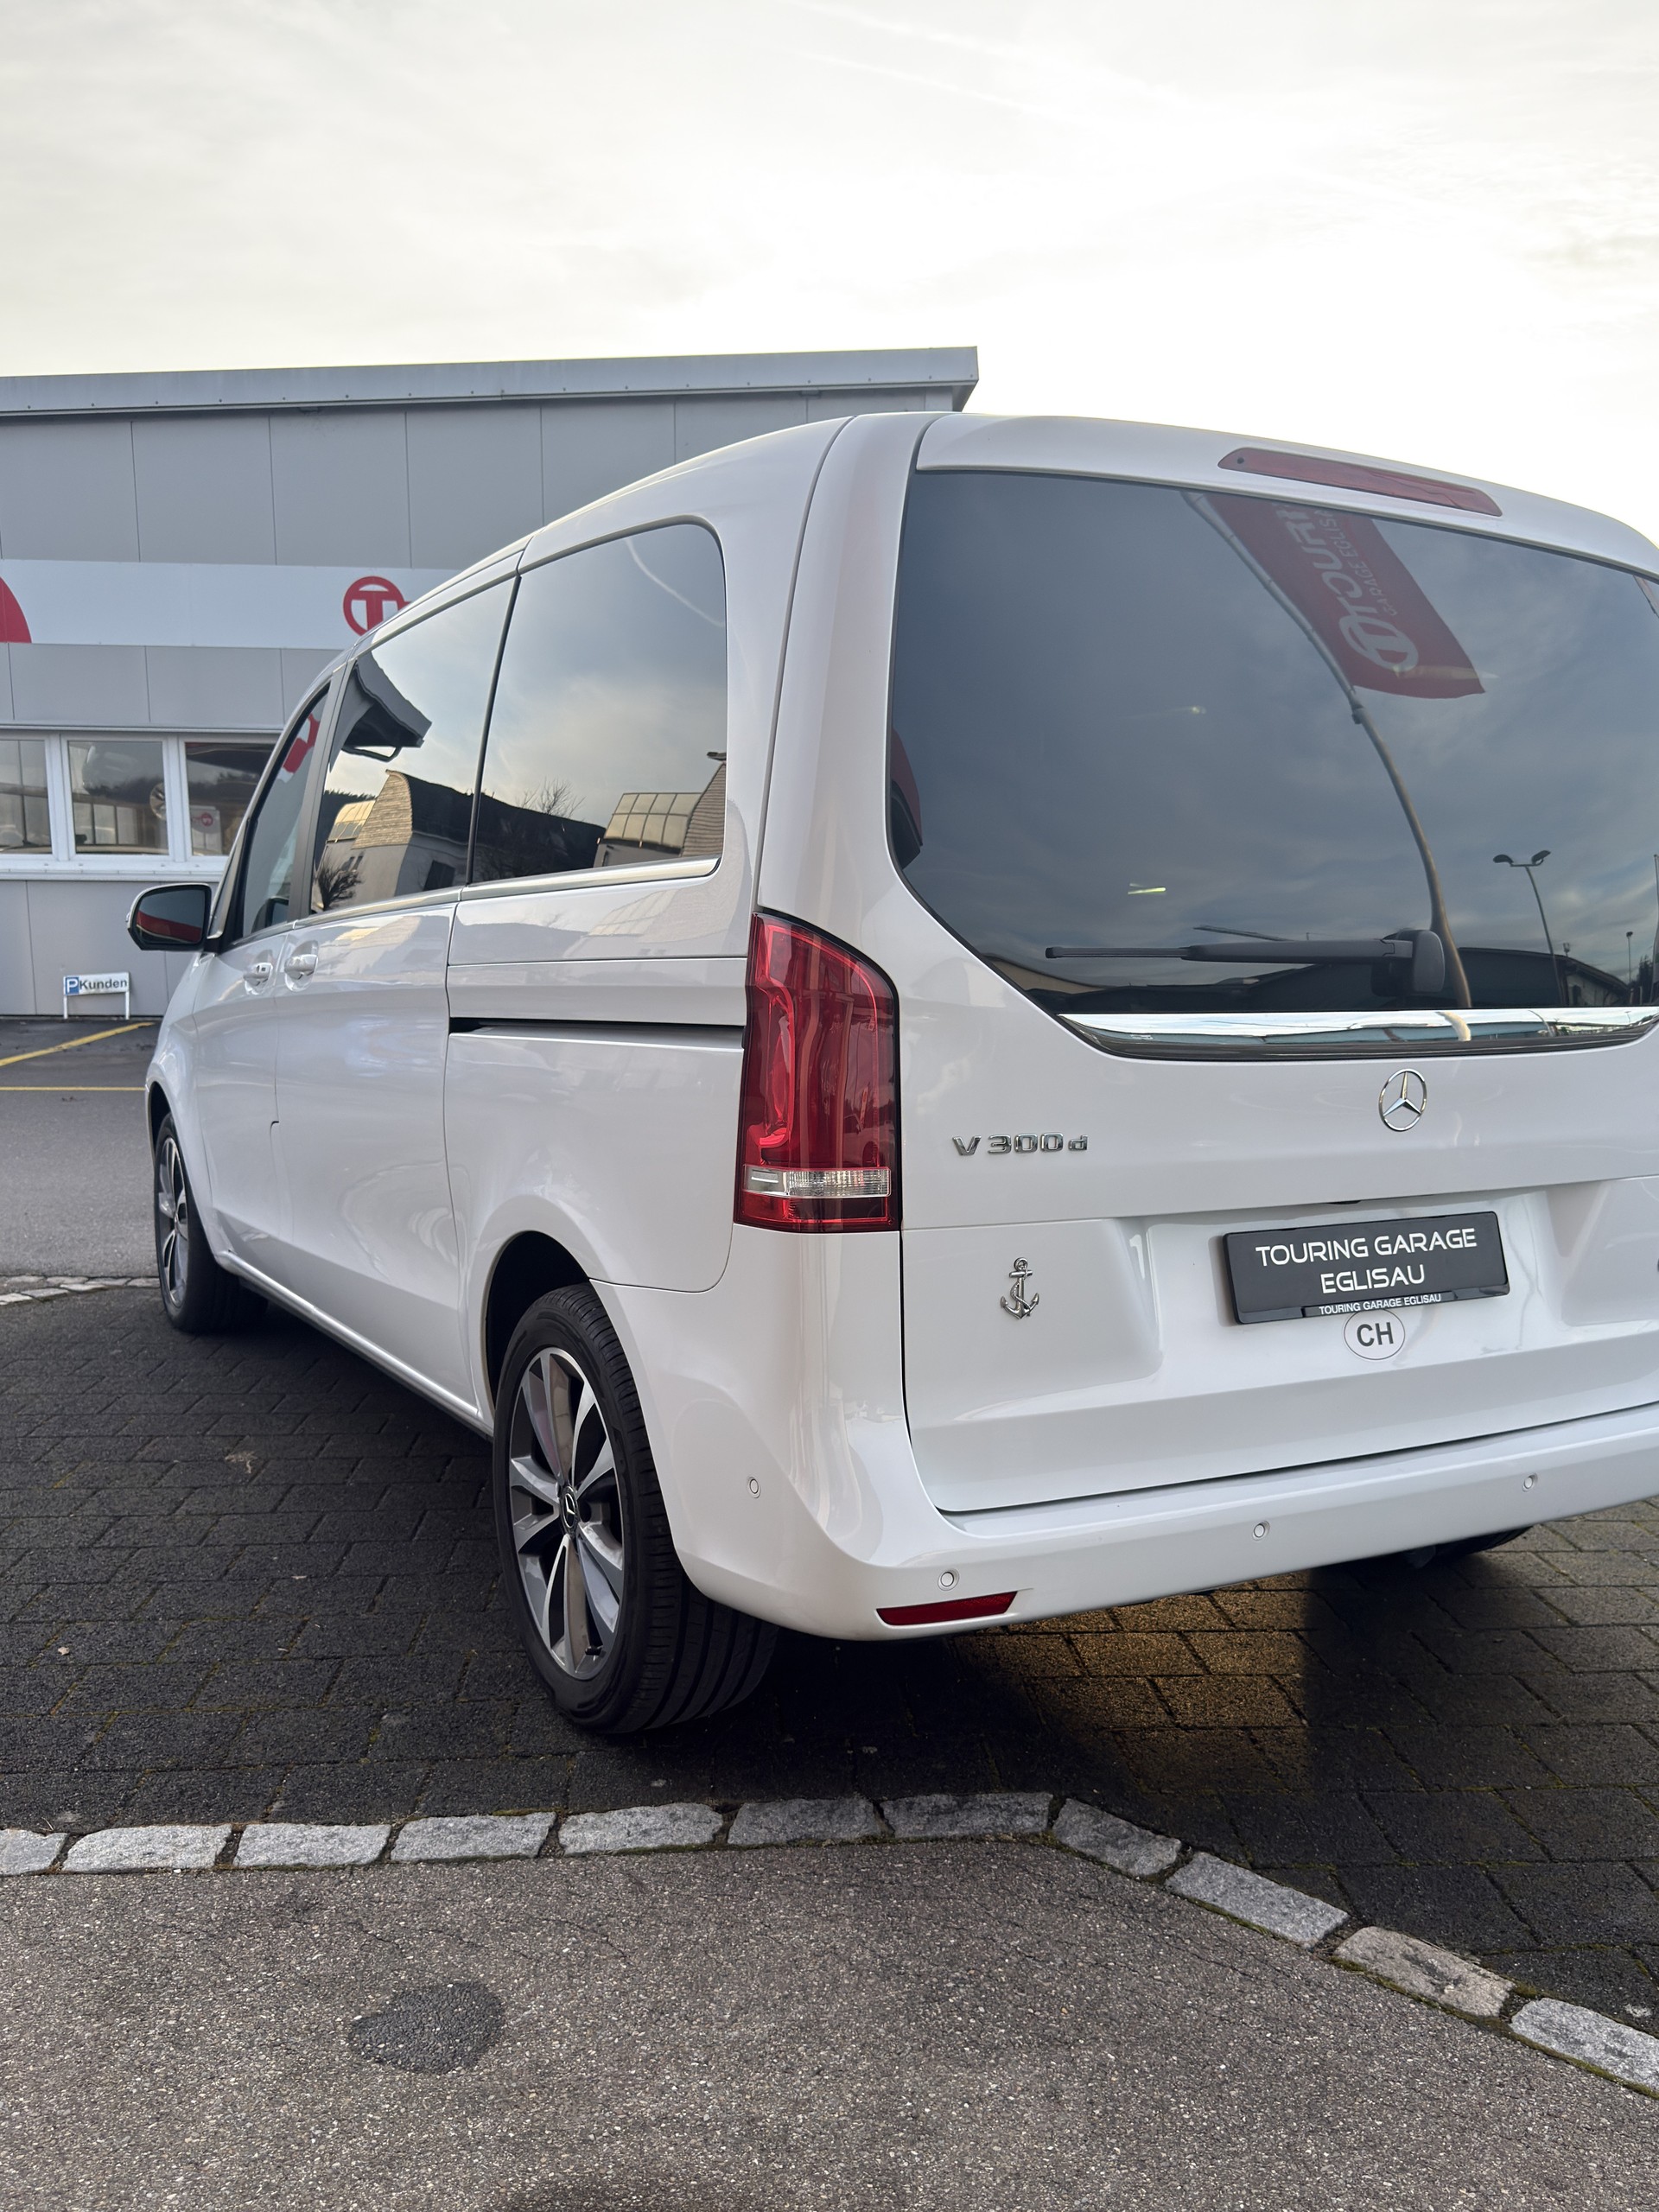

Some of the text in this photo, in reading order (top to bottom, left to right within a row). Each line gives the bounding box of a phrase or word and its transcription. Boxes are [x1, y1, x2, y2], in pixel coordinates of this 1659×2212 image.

[79, 979, 127, 990] Kunden
[1255, 1228, 1478, 1266] TOURING GARAGE
[1320, 1264, 1425, 1294] EGLISAU
[1319, 1294, 1441, 1315] TOURING GARAGE EGLISAU
[1357, 1322, 1394, 1347] CH
